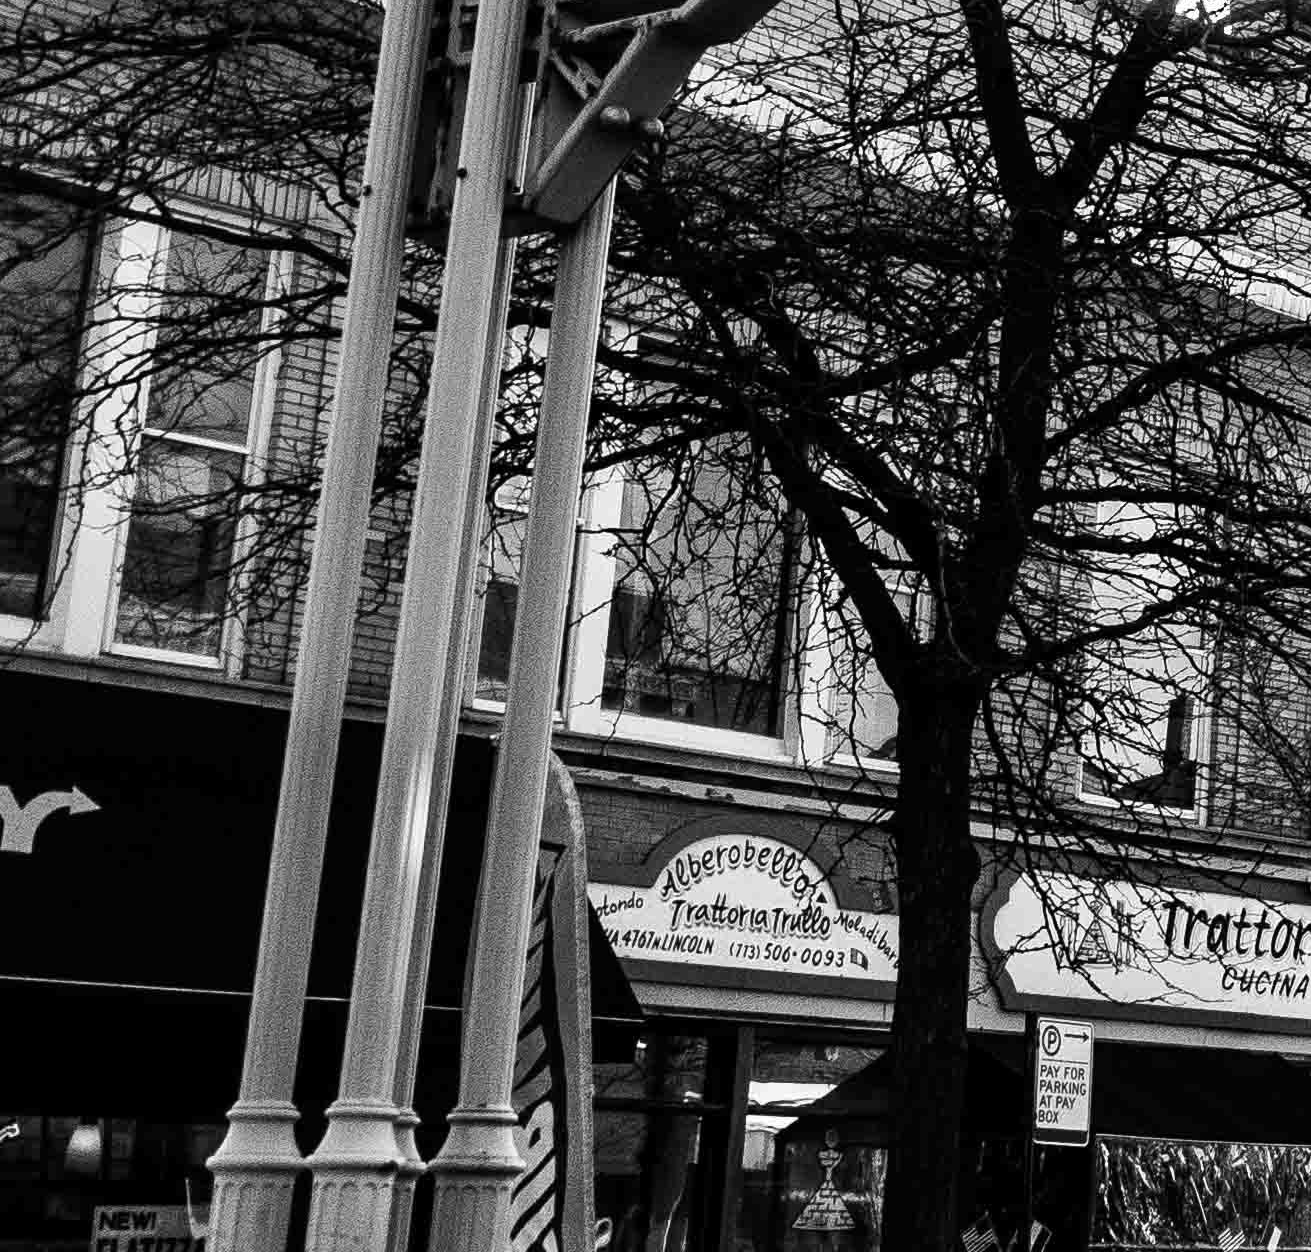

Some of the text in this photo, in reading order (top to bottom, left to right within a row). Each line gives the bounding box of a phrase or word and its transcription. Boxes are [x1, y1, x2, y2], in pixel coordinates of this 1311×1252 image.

[661, 840, 811, 897] Alberobello
[671, 894, 830, 936] Trattoria Trullo
[730, 942, 760, 960] (773)
[1221, 965, 1310, 1000] CUCINA
[1040, 1065, 1085, 1081] PAY FOR
[1039, 1080, 1087, 1096] PARKING
[1039, 1095, 1076, 1109] AT PAY
[1038, 1109, 1059, 1124] BOX
